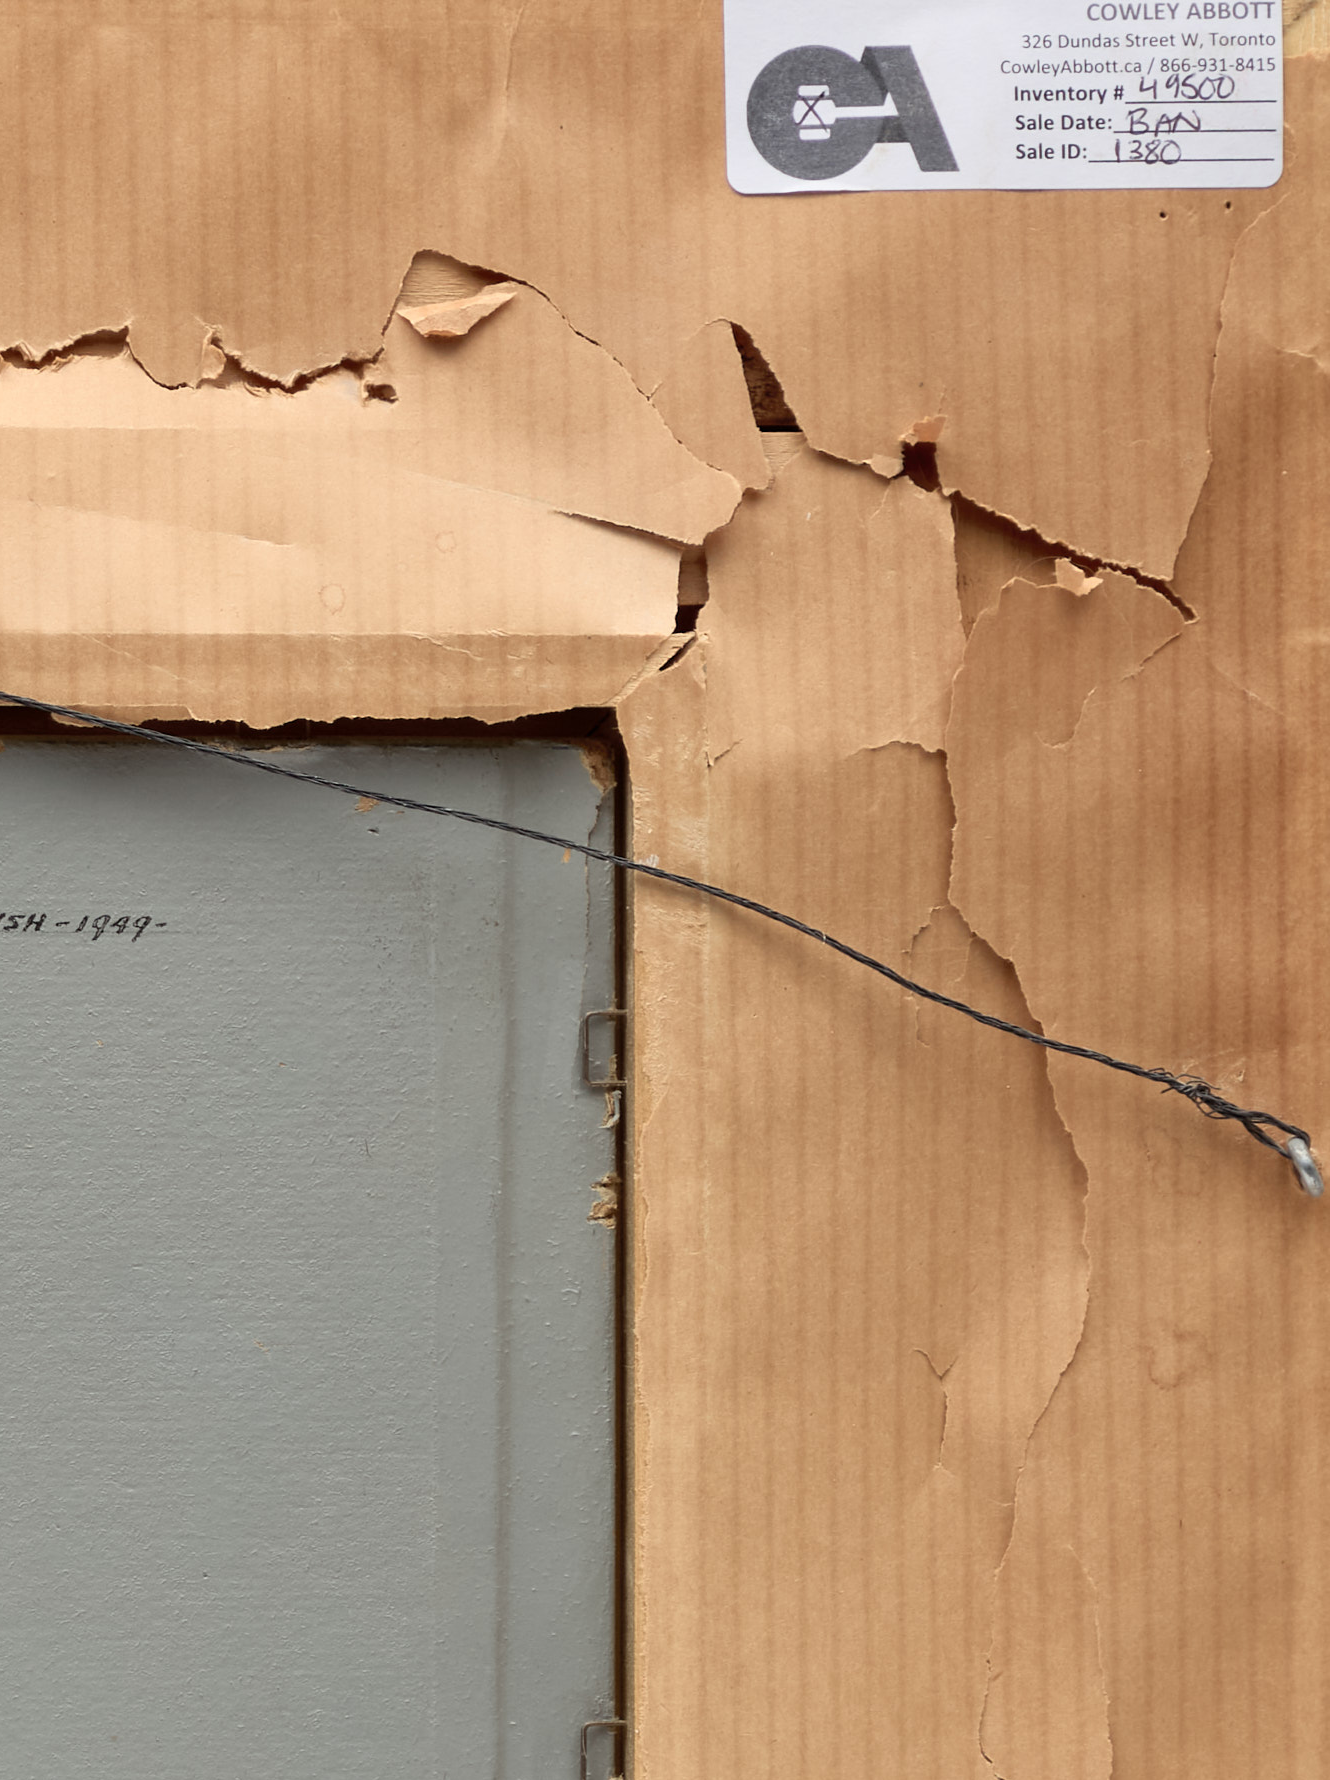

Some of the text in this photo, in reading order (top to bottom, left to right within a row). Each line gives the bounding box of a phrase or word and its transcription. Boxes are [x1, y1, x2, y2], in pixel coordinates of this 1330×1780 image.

[1086, 1, 1276, 21] COWLEY ABBOTT
[1021, 32, 1276, 49] 326 Dundas Street W, Toronto
[1000, 59, 1142, 77] CowleyAbbott.ca
[1160, 57, 1276, 73] 866-931-8415
[1014, 85, 1108, 104] Inventory
[1138, 73, 1236, 101] 49500
[1015, 107, 1202, 137] Sale Date: BAN
[1015, 138, 1182, 165] Sale ID: 1380
